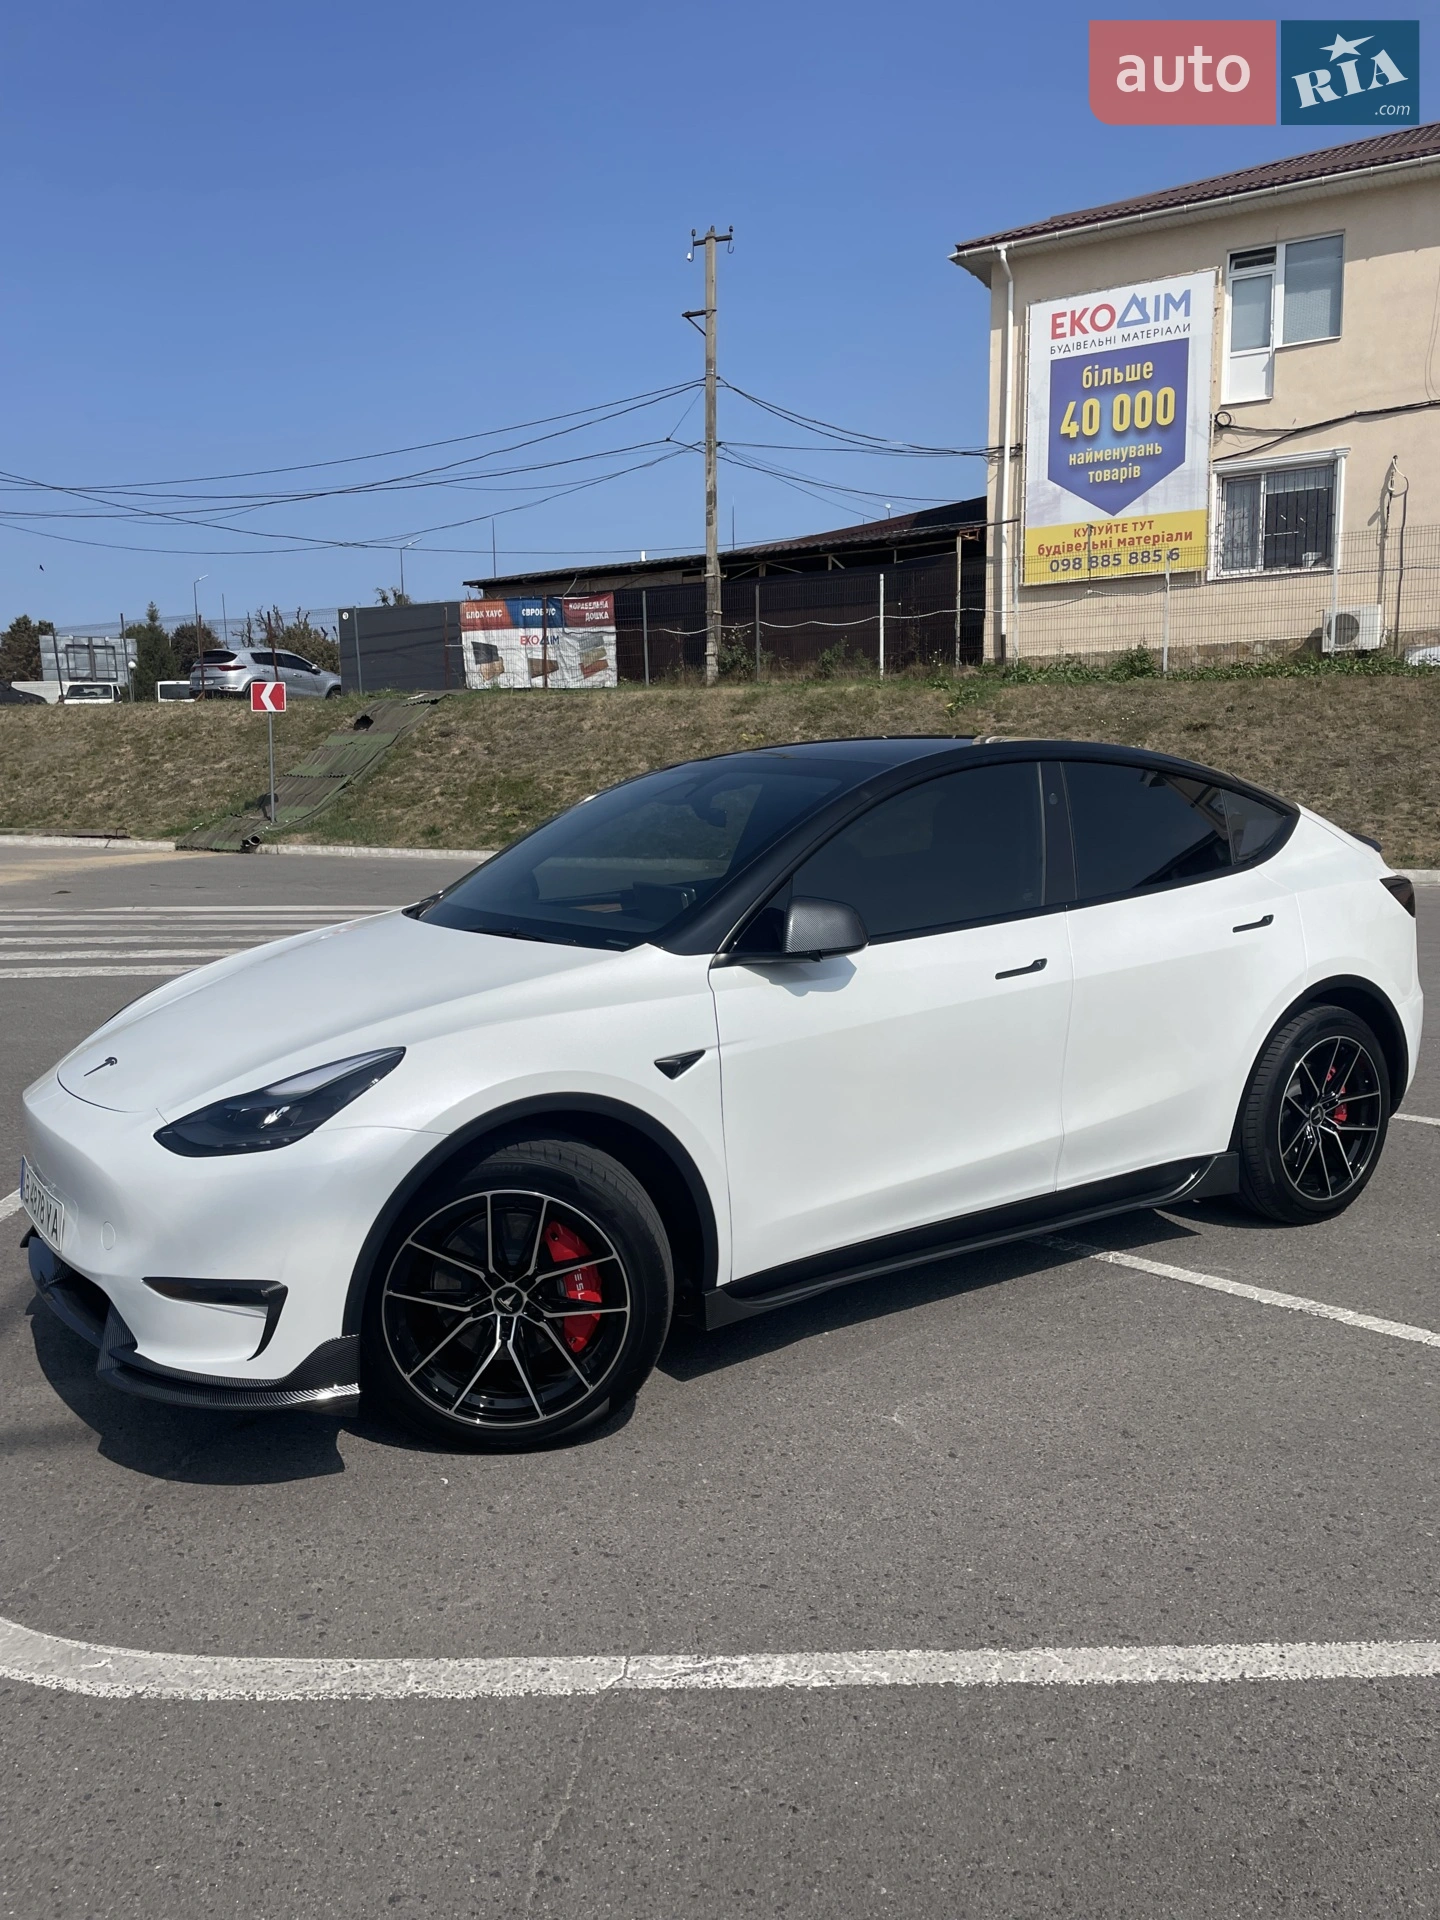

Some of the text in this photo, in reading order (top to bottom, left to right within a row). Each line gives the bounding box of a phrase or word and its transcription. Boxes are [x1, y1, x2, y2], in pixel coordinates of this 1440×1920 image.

[1051, 289, 1191, 340] ЕКОДІМ
[1050, 323, 1191, 355] БУДІВЕЛЬНІ МАТЕРІАЛИ
[1082, 361, 1154, 389] більше
[1060, 386, 1176, 438] 40 000
[1069, 442, 1163, 466] найменувань
[1088, 463, 1141, 484] товарів
[1132, 520, 1155, 532] ТУТ
[1037, 531, 1193, 557] будівельні матеріали
[1050, 547, 1180, 573] 098 885 885 6
[466, 609, 503, 619] БЛОК ХАУС
[585, 611, 609, 622] ДОШКА
[574, 1268, 585, 1300] ESL
